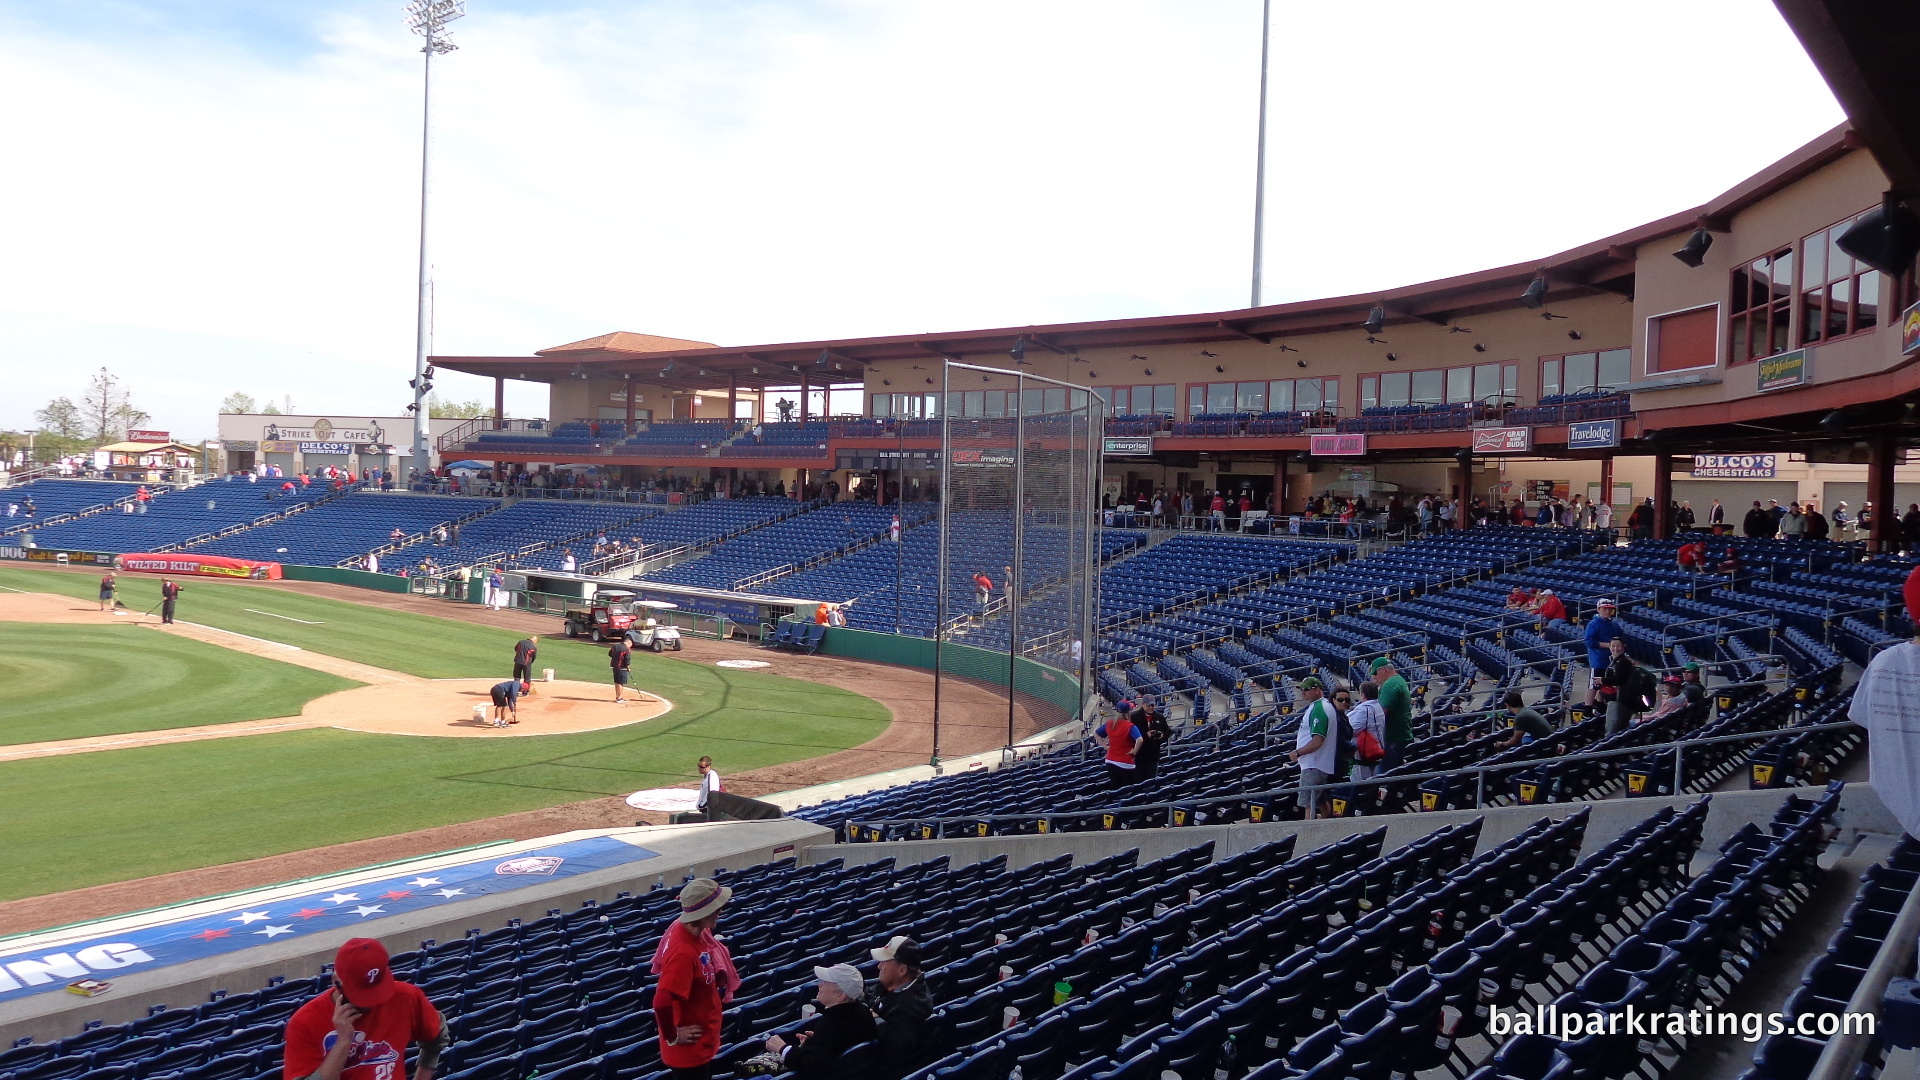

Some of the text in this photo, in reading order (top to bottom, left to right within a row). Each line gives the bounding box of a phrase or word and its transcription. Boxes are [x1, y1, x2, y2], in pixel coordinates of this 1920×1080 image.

[129, 430, 170, 441] Budweiser
[281, 429, 366, 440] STRIKE OUT CAFE
[1571, 425, 1611, 442] Travelodge
[301, 442, 350, 450] DELCO'S
[1108, 442, 1148, 450] enterprise
[980, 455, 1015, 464] imaging
[1695, 455, 1775, 468] DELCO'S
[1694, 468, 1772, 477] CHEESESTEAKS
[127, 560, 196, 572] TILTED KILT
[367, 968, 380, 984] P
